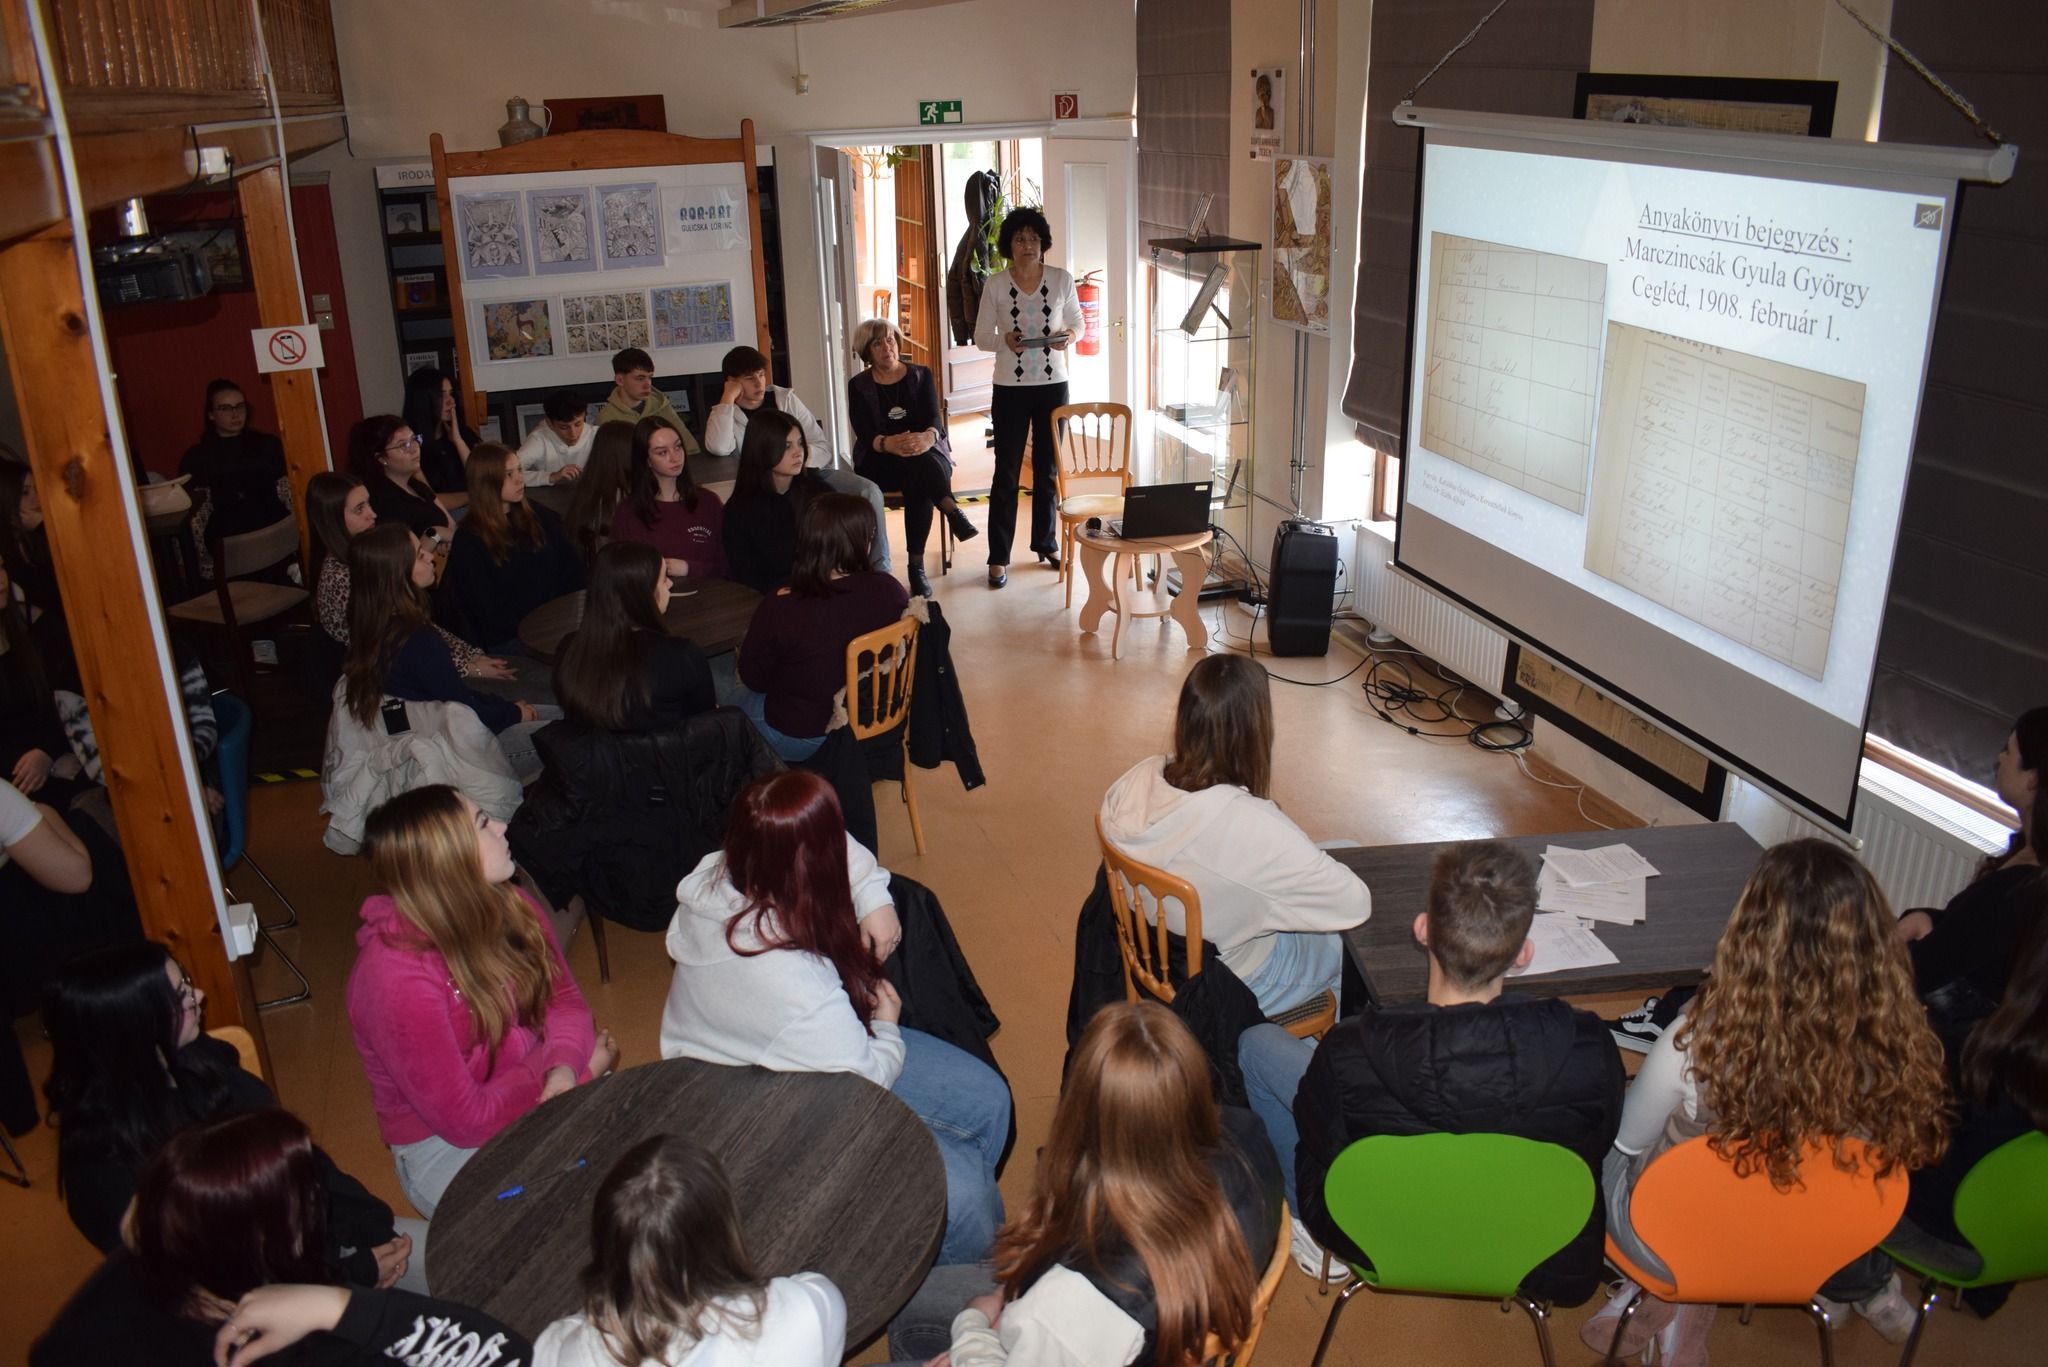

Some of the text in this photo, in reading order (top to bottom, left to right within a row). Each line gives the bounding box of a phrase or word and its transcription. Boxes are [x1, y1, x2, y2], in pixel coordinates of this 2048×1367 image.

[398, 170, 434, 181] IRODA
[1639, 203, 1740, 241] Anyakönyvi
[1745, 216, 1839, 254] bejegyzés
[1625, 236, 1870, 310] Marczincsák Gyula György
[1632, 274, 1840, 342] Cegléd, 1908. február 1.
